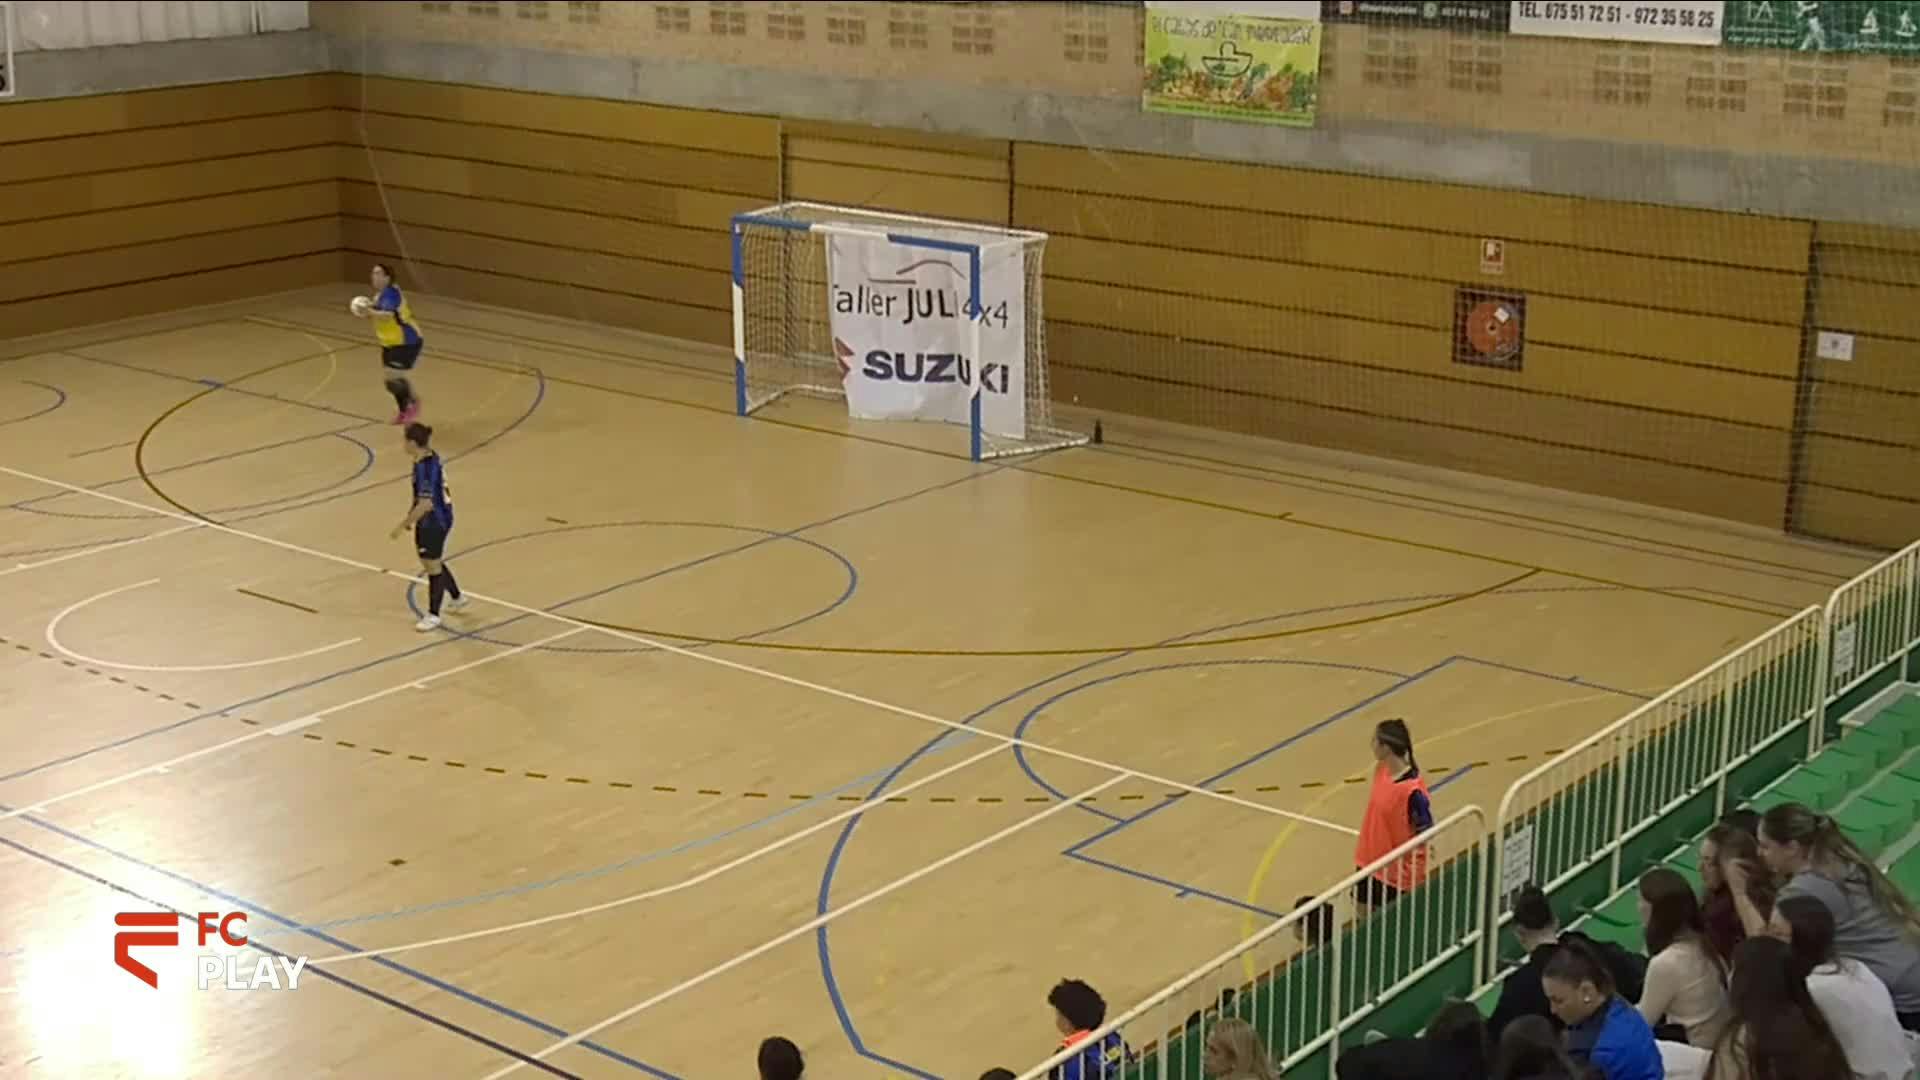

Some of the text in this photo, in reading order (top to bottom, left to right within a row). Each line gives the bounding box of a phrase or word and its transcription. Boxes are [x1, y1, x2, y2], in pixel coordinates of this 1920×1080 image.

[1570, 4, 1585, 22] 51
[1588, 5, 1604, 23] 72
[1607, 6, 1621, 23] 51
[1634, 7, 1658, 25] 972
[1661, 8, 1677, 26] 35
[1680, 8, 1695, 27] 58
[1697, 9, 1715, 28] 25
[833, 283, 897, 318] aller
[862, 350, 1008, 394] SUZUKI
